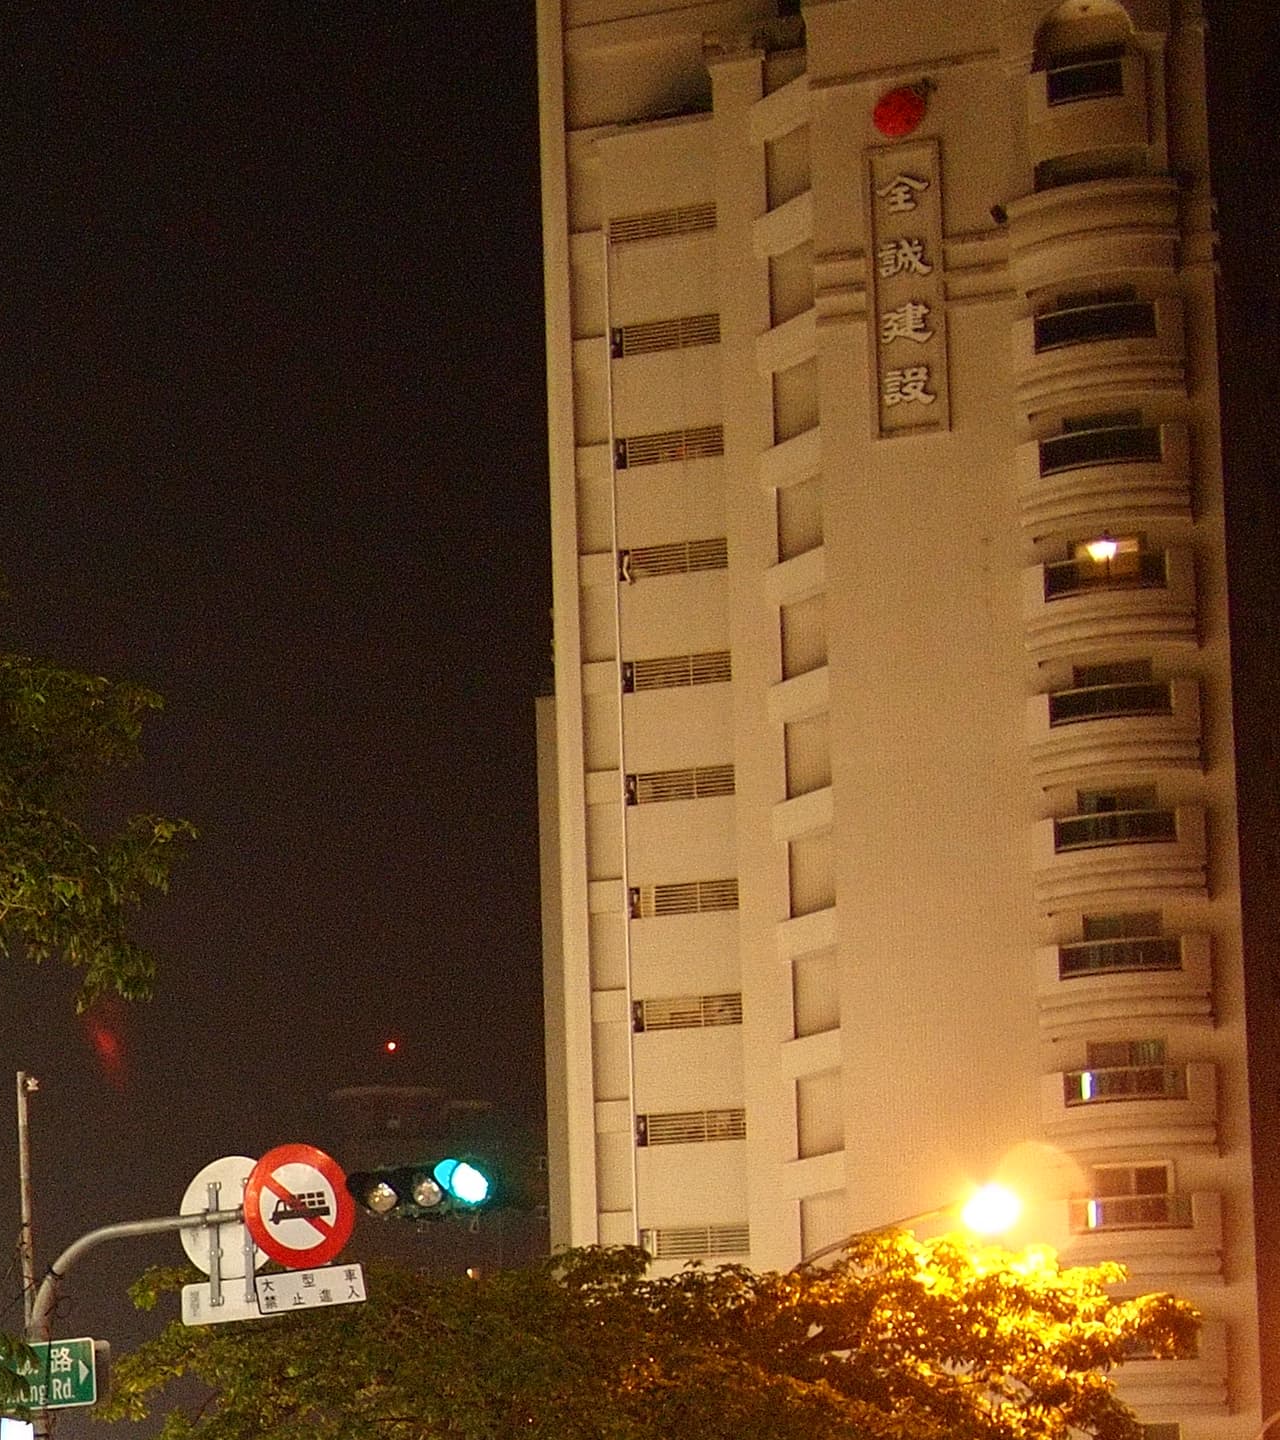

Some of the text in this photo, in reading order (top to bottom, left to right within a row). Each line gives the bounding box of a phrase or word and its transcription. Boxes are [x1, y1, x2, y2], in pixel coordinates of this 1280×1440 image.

[876, 174, 935, 406] 全誠建設
[261, 1268, 358, 1293] 大型車
[264, 1285, 361, 1310] 禁止進入
[52, 1377, 75, 1400] Rd.
